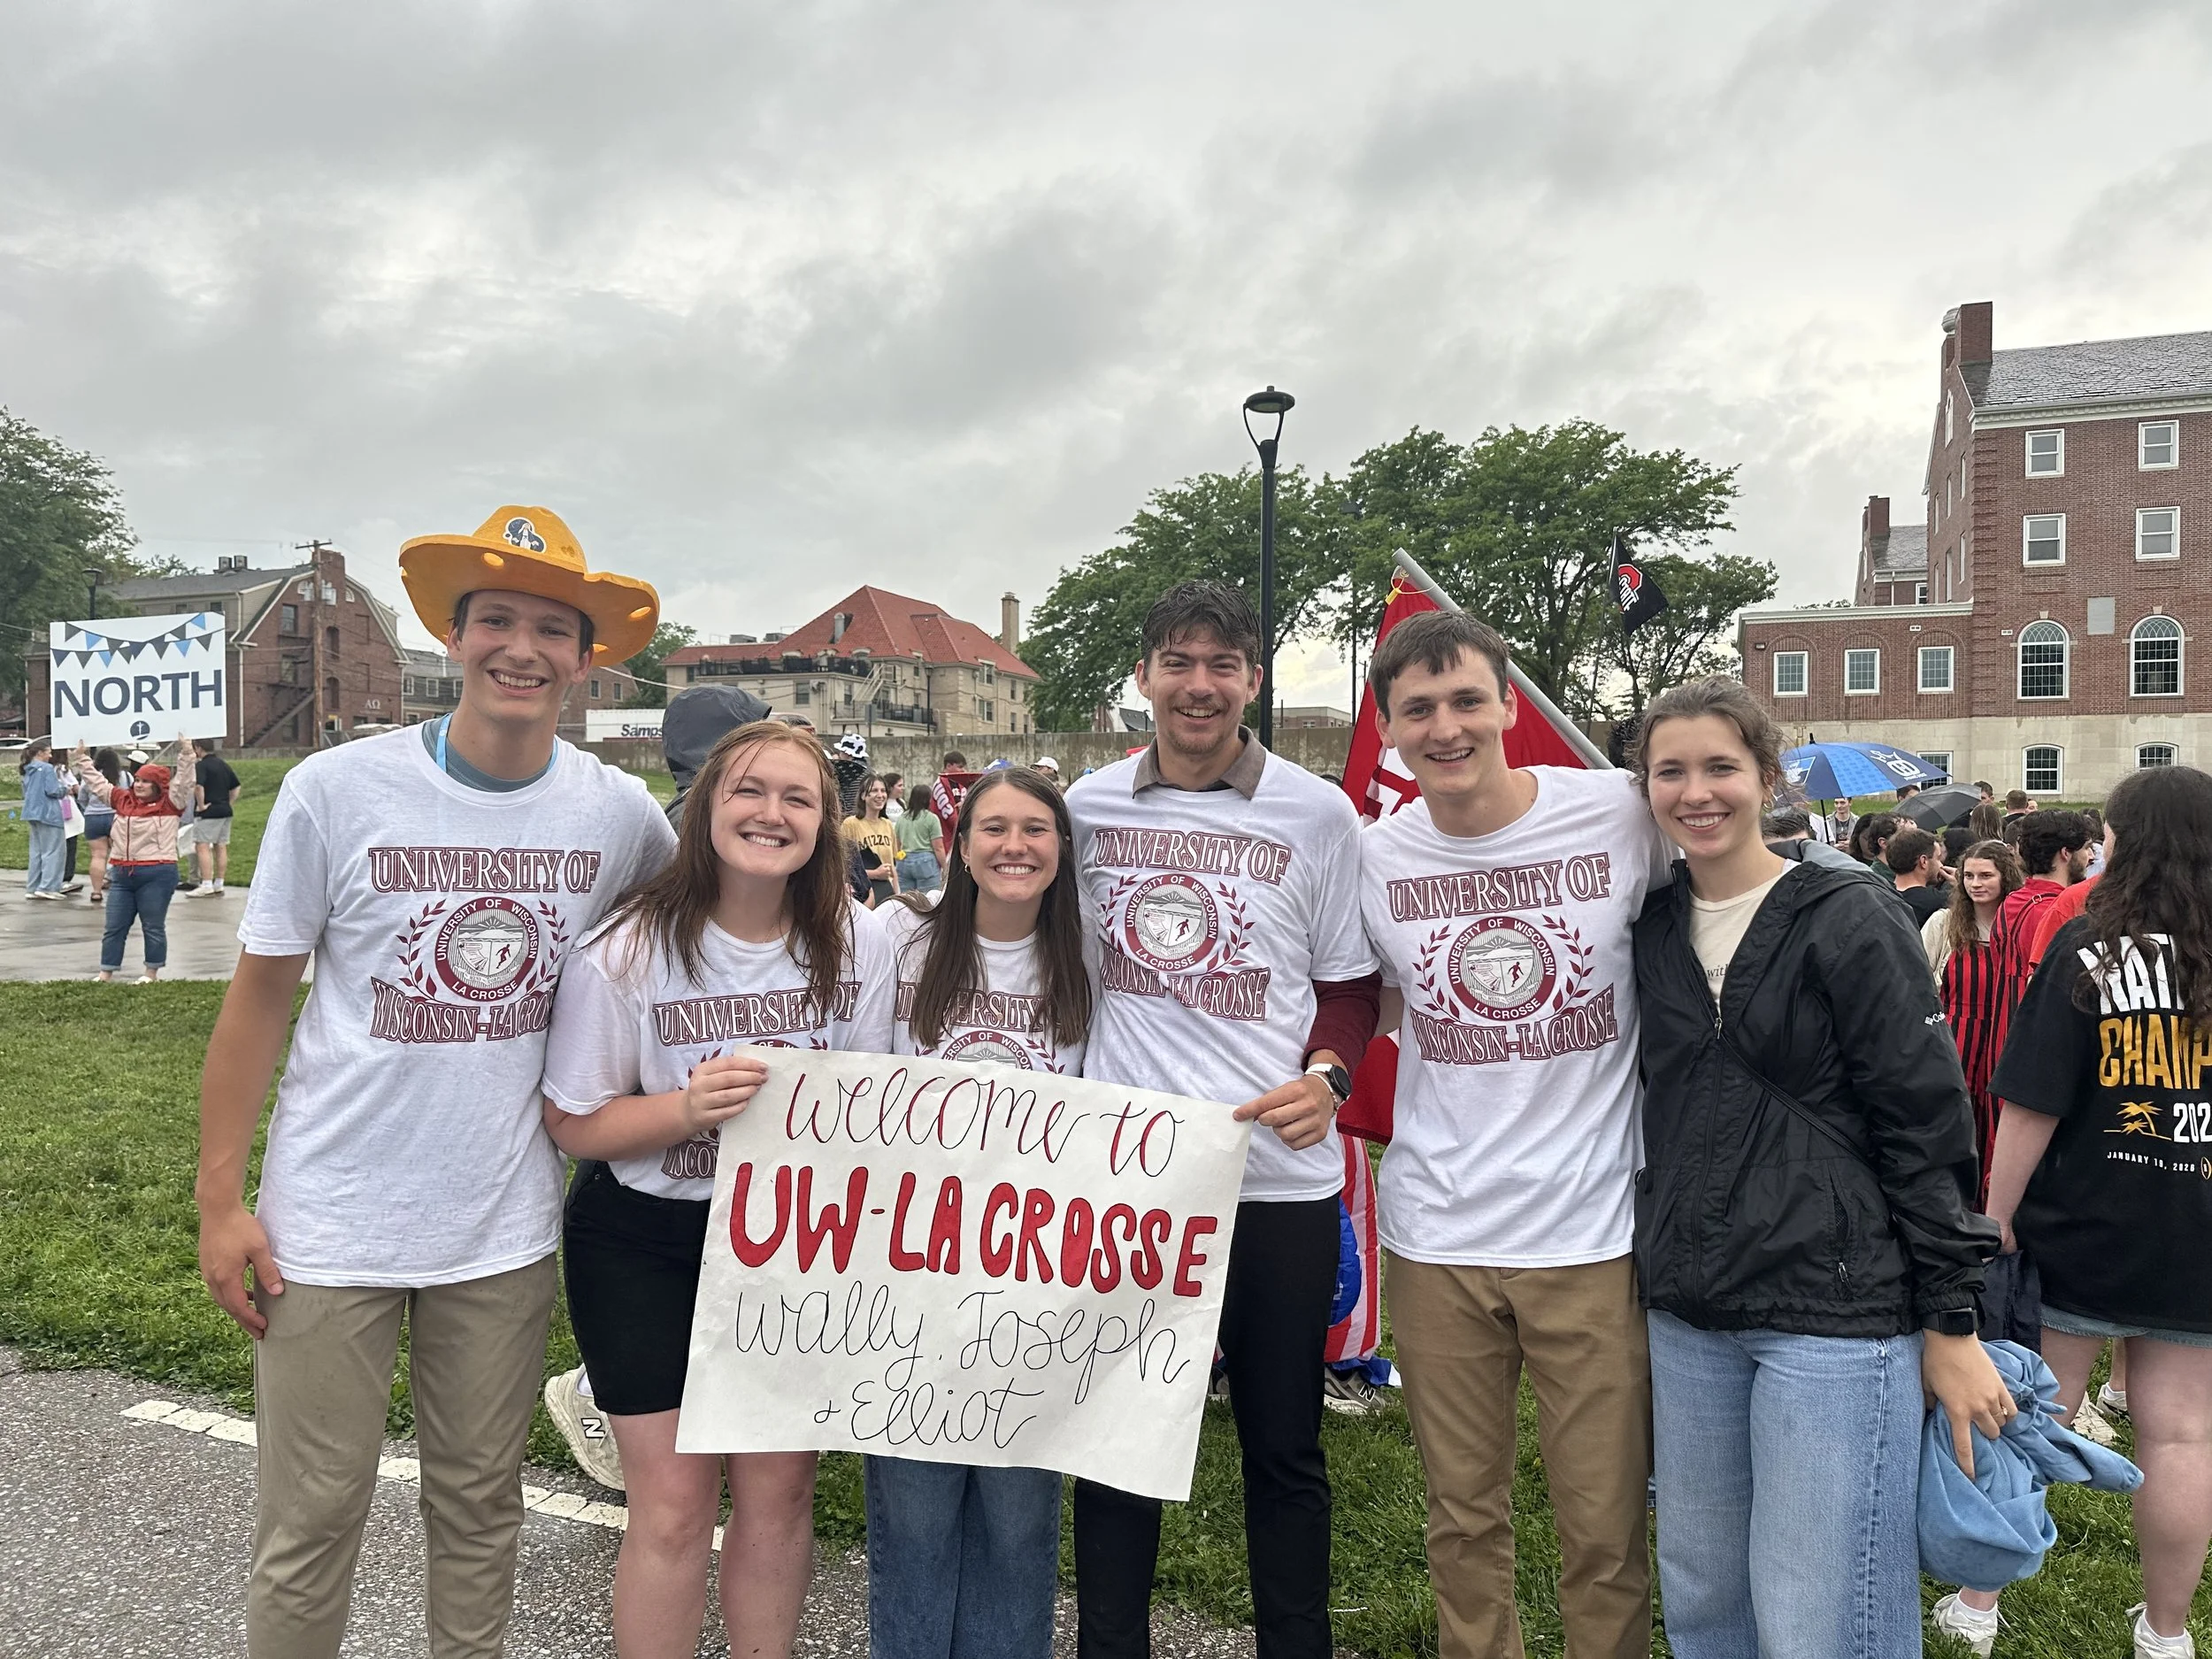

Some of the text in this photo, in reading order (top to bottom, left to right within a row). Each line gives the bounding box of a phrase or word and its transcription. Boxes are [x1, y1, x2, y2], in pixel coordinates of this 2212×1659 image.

[54, 669, 222, 718] NORTH
[368, 848, 602, 894] UNIVERSITY OF
[1095, 827, 1292, 886] UNIVERSITY OF
[1386, 852, 1611, 923] UNIVERSITY OF
[436, 899, 537, 961] UNIVERSITY OF WISCONSIN
[1126, 876, 1217, 940] UNIVERSITY OF WISCONSIN
[1135, 948, 1148, 960] LA
[1149, 956, 1196, 970] CROSSE
[1448, 918, 1555, 985] UNIVERSITY OF WISCONSIN
[451, 980, 518, 1000] LA CROSSE
[652, 980, 863, 1047] UNIVERSITY OF
[1195, 967, 1271, 1021] CROSSE
[1473, 997, 1541, 1019] LA CROSSE
[1548, 982, 1619, 1057] CROSSE
[978, 1033, 993, 1041] OF
[1099, 1101, 1185, 1178] to
[2107, 1151, 2149, 1164] JANUARY
[2172, 1163, 2195, 1172] 2026
[729, 1162, 1218, 1297] UW-LA CROSSE
[957, 1289, 1191, 1405] Joseph
[851, 1377, 1045, 1449] Elliot
